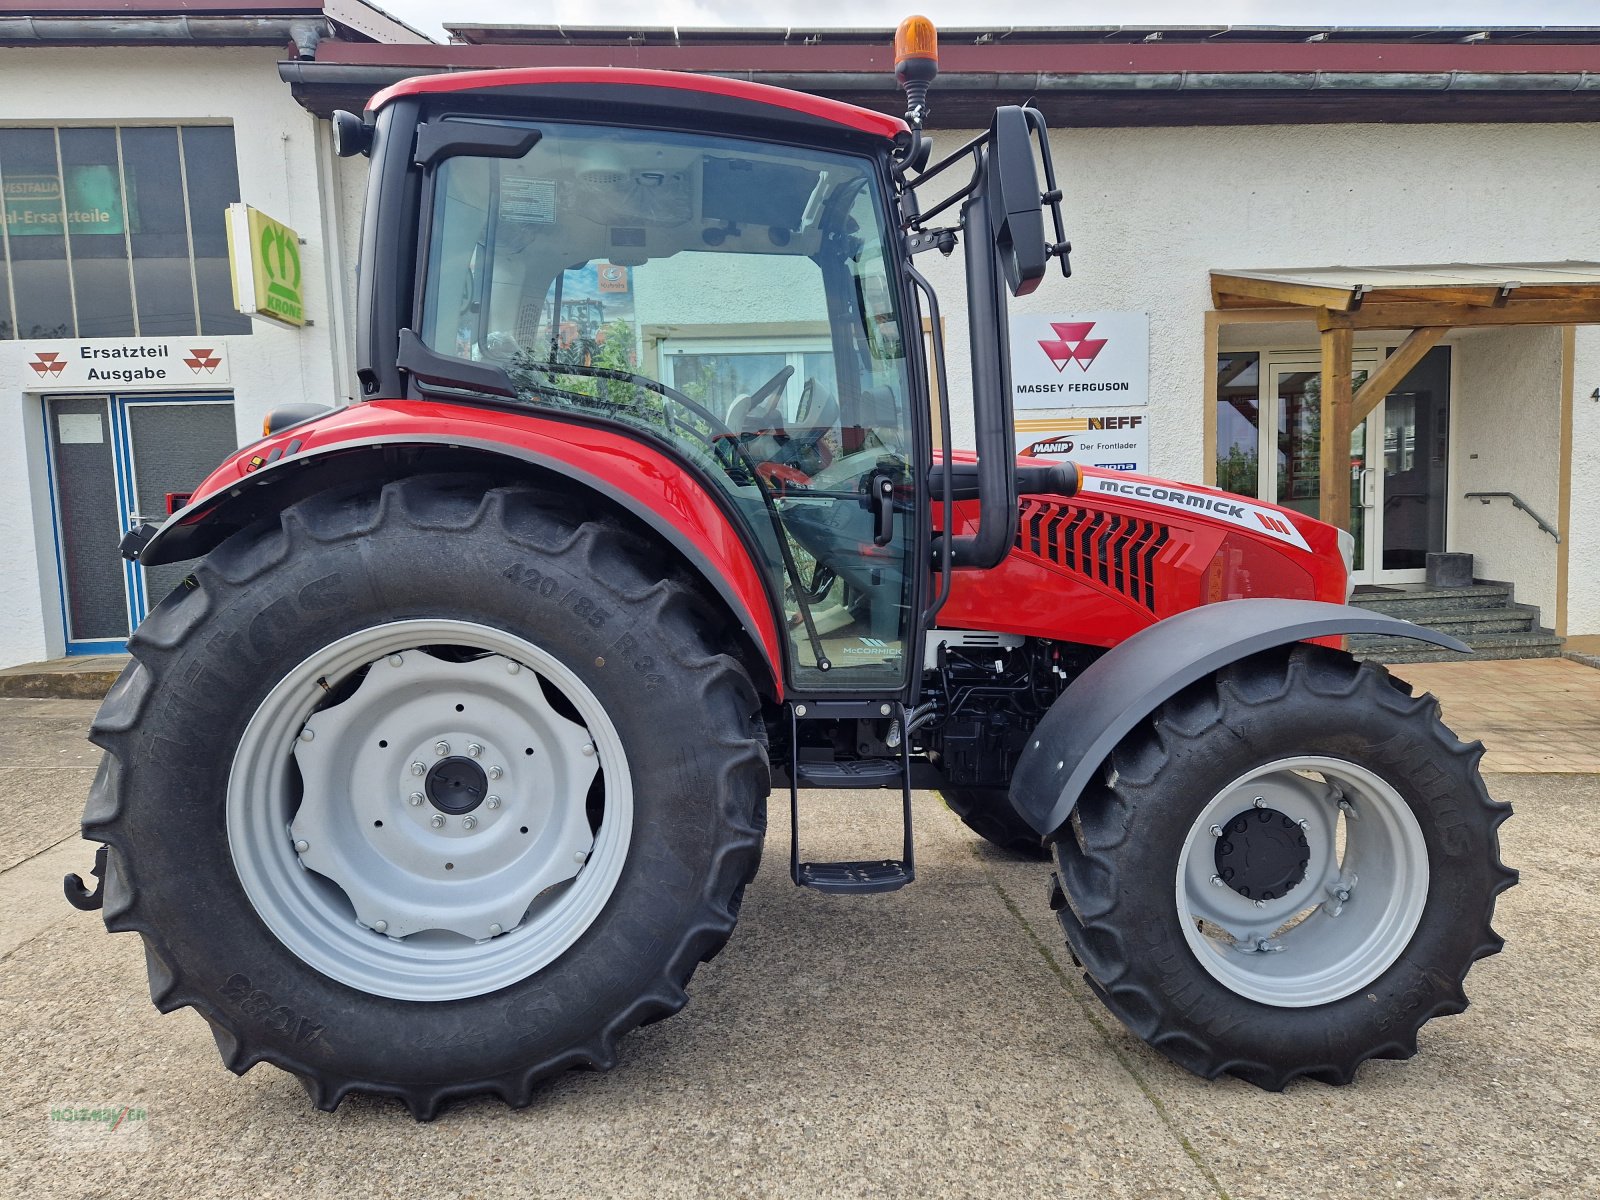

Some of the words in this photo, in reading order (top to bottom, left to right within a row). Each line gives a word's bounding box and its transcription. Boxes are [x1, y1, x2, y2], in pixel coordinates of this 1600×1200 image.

[267, 294, 302, 319] KRONE
[80, 345, 169, 359] Ersatzteil
[87, 366, 167, 382] Ausgabe
[1017, 383, 1064, 393] MASSEY
[1068, 382, 1129, 392] FERGUSON
[1088, 416, 1142, 430] NEFF
[1080, 443, 1094, 451] Der
[1097, 442, 1137, 450] Frontlader
